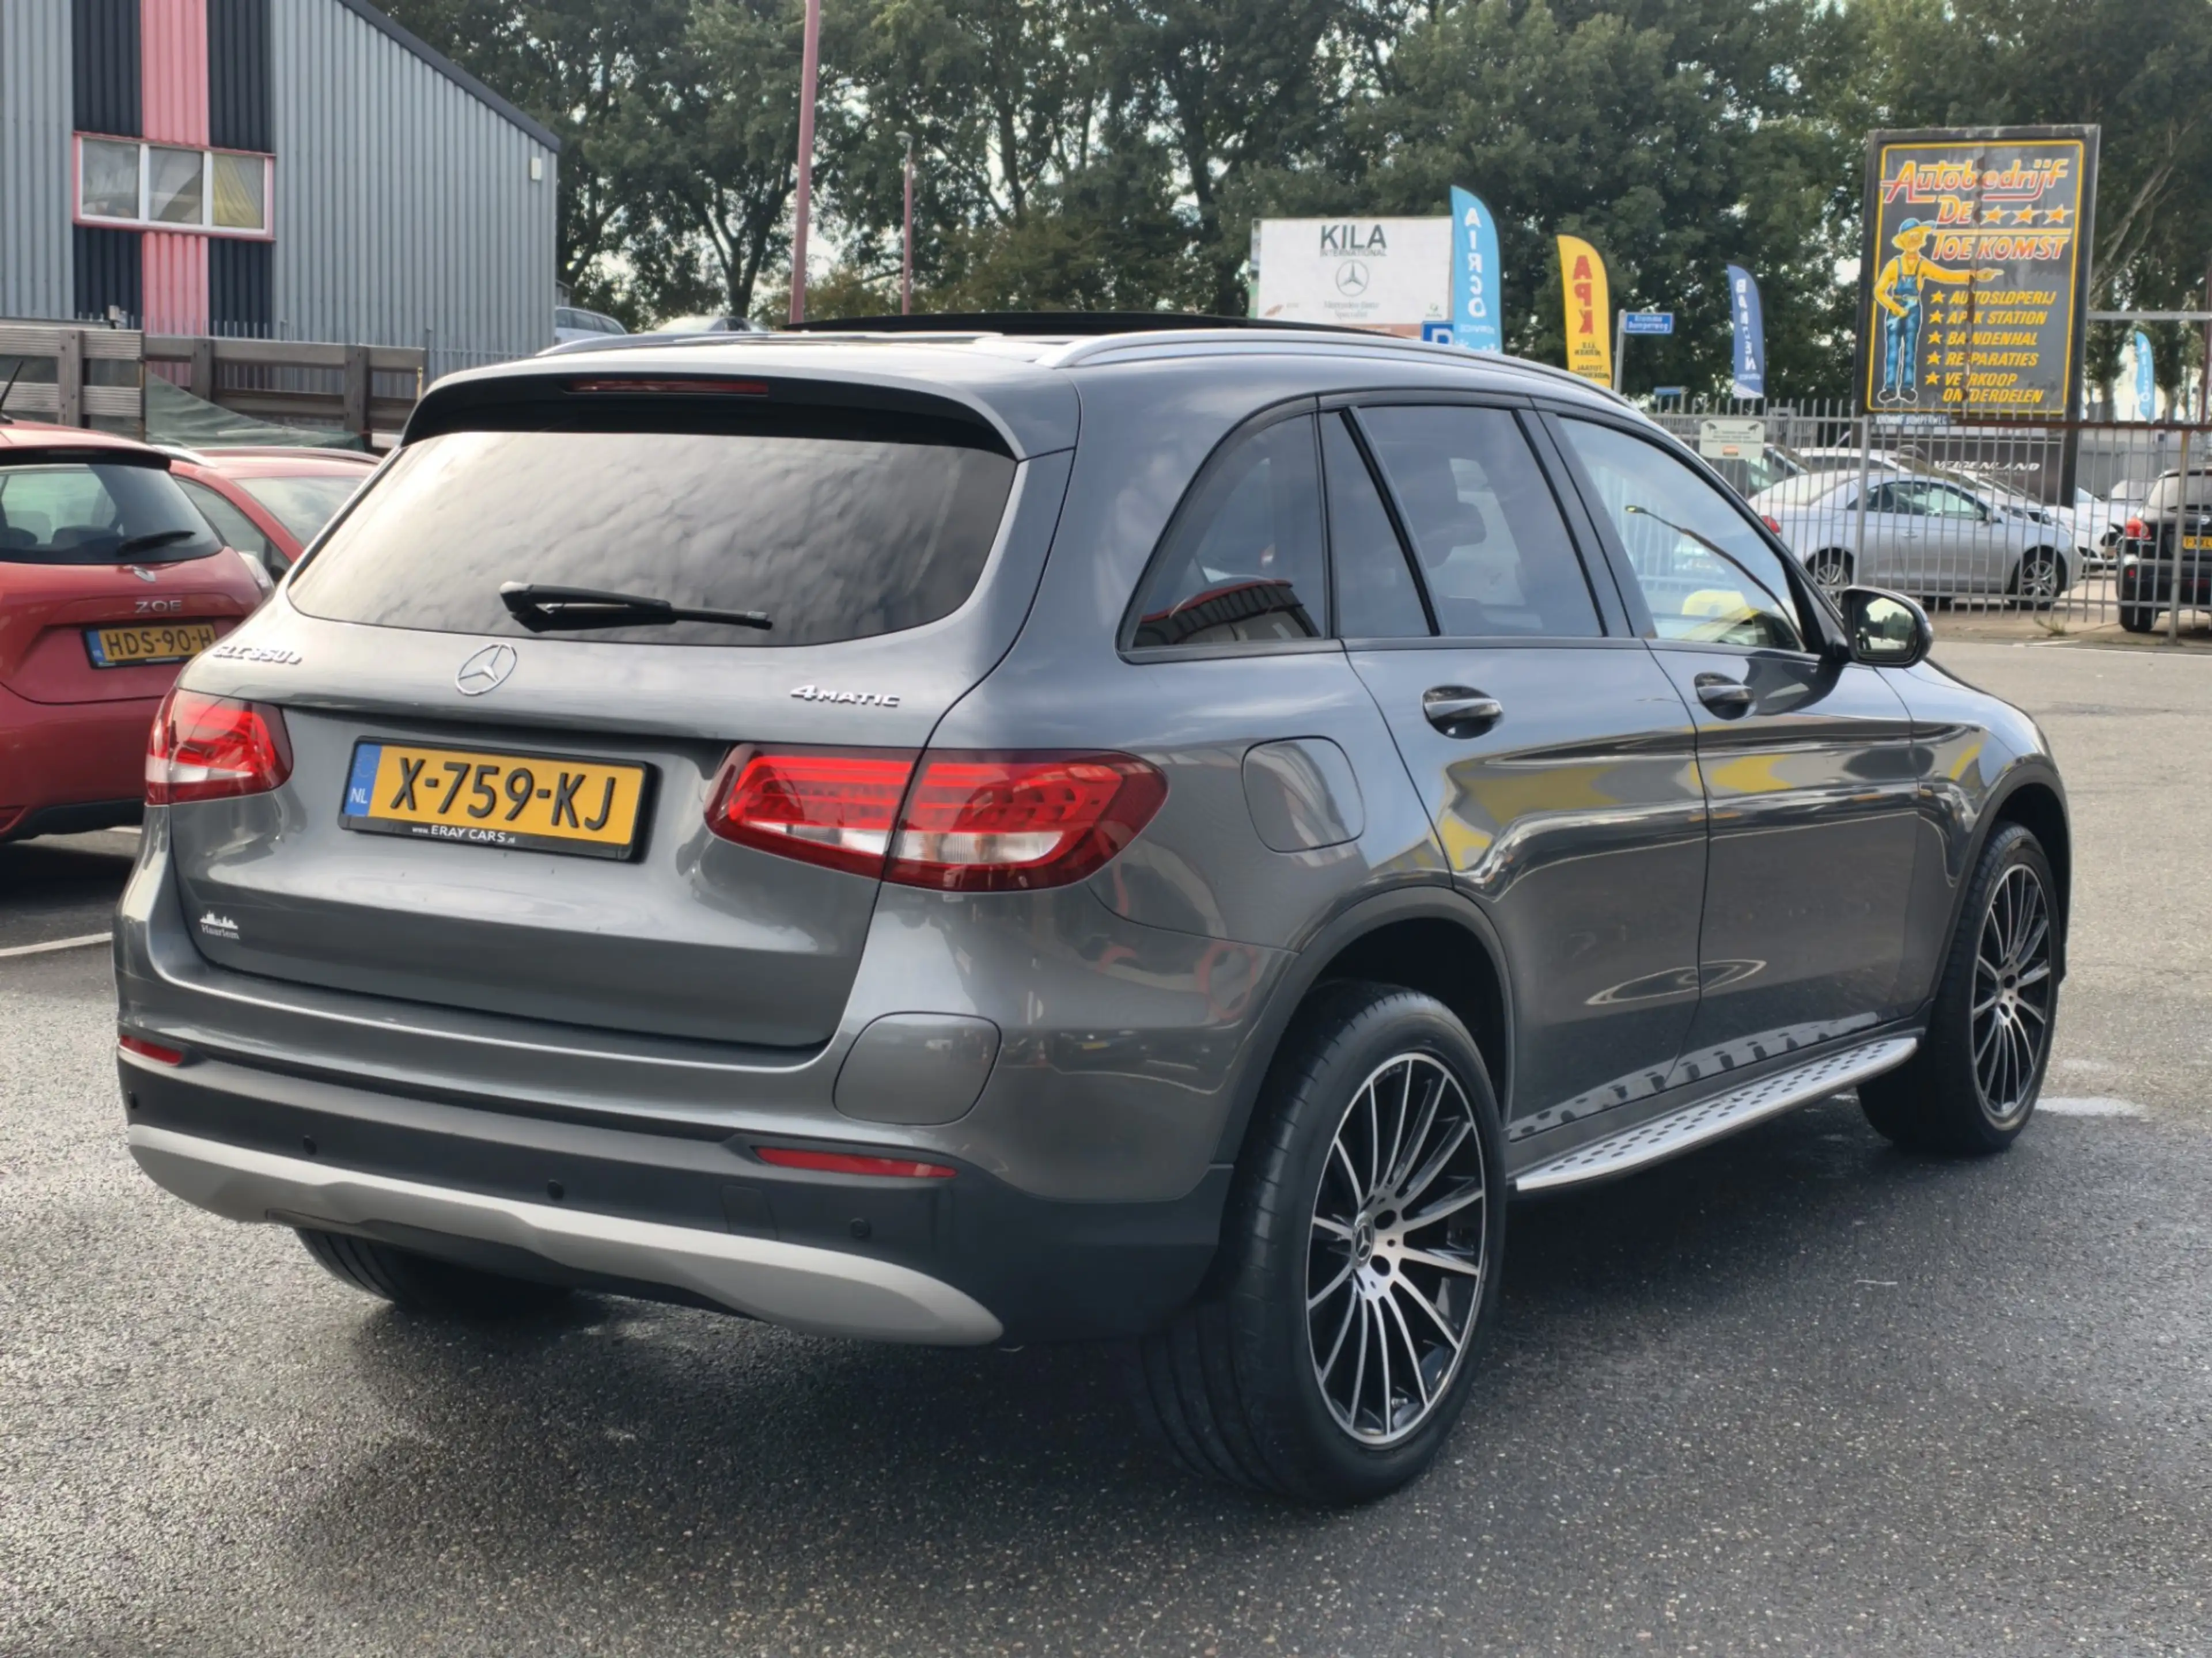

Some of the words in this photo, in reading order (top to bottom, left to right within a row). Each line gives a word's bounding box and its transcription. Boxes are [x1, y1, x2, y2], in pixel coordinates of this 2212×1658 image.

[1880, 158, 2069, 203] Autobedrijf
[1320, 223, 1388, 249] KILA
[1320, 248, 1388, 257] INTERNATIONAL
[1987, 311, 2048, 325] STATION
[1945, 351, 2040, 366] REPARATIES
[1944, 371, 2018, 386] VERKOOP
[134, 600, 183, 614] ZOE
[790, 684, 900, 708] 4MATIC
[350, 787, 368, 805] NL
[389, 757, 617, 832] X-759-KJ
[431, 825, 466, 838] ERAY
[469, 829, 506, 843] CARS
